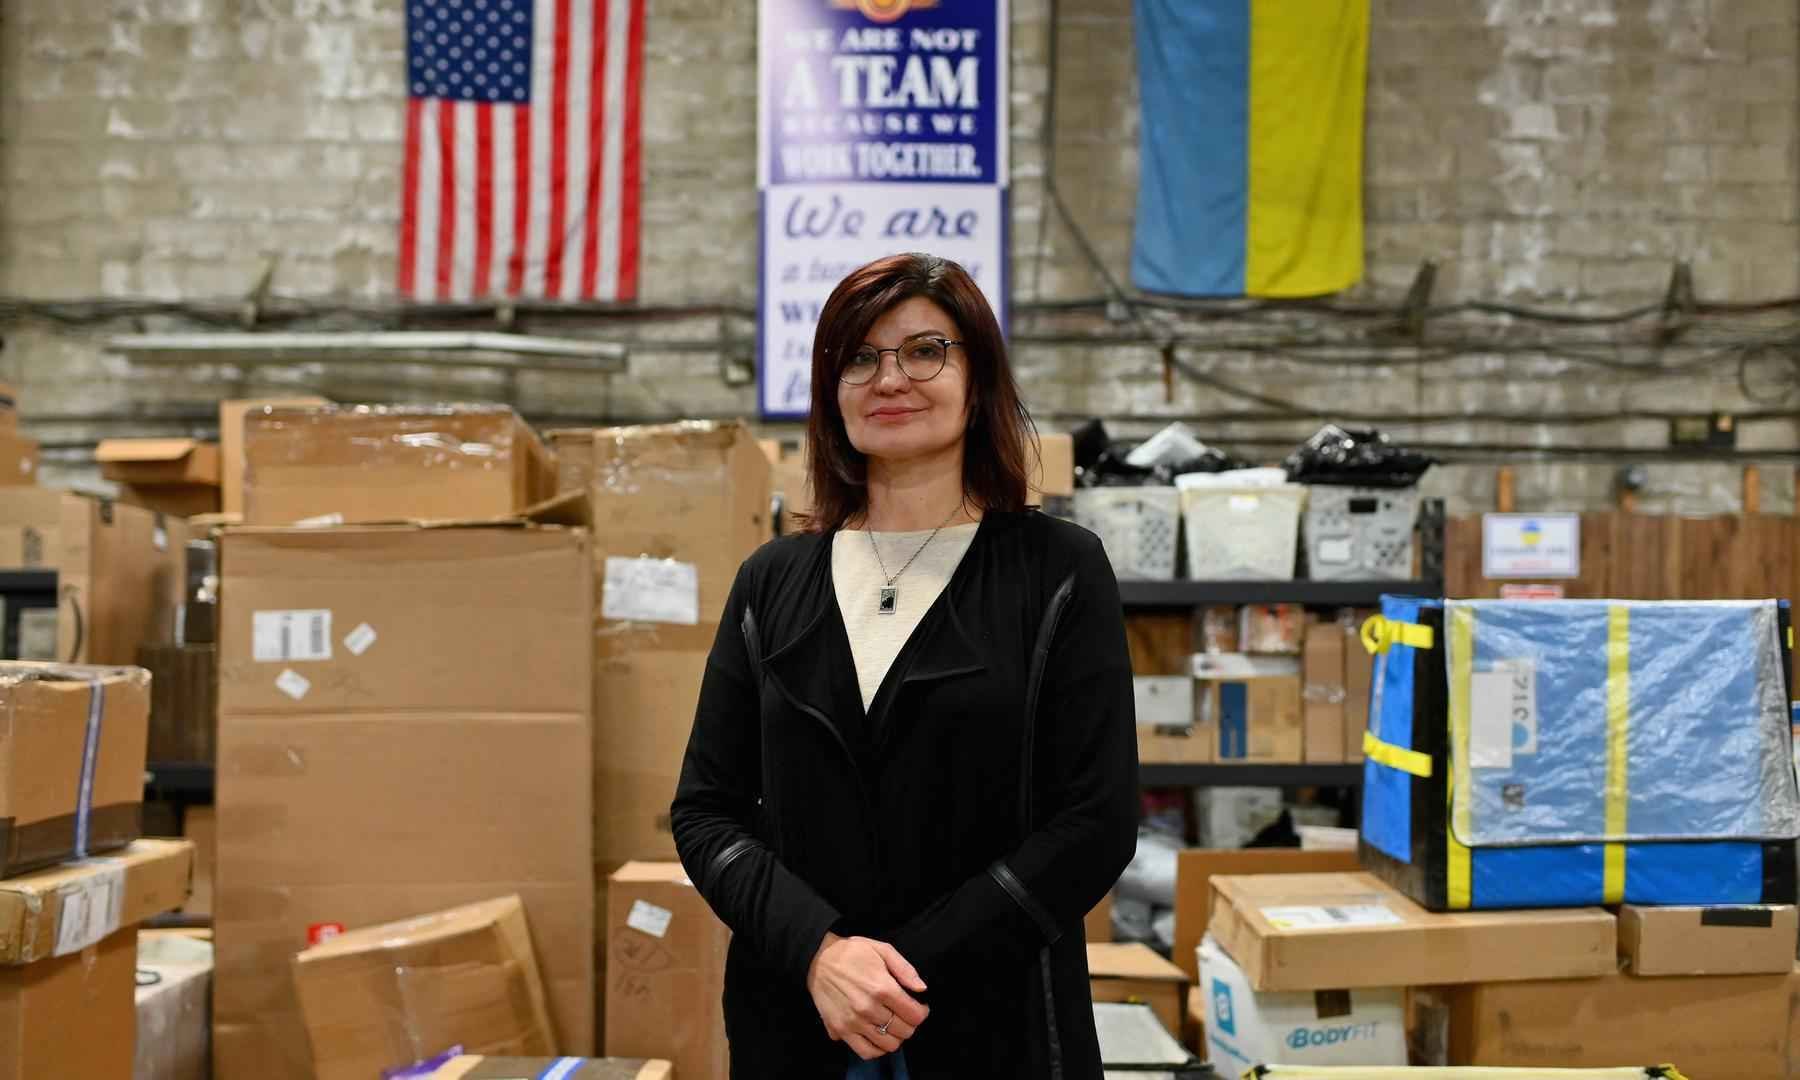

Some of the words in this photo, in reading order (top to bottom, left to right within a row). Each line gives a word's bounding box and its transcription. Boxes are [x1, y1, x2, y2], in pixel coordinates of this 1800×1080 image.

[783, 28, 833, 50] WE
[839, 27, 901, 51] ARE
[909, 28, 981, 51] NOT
[783, 56, 818, 108] A
[832, 54, 980, 108] TEAM
[782, 114, 922, 135] BECAUSE
[930, 114, 977, 135] WE
[785, 195, 865, 239] We
[880, 207, 978, 238] are
